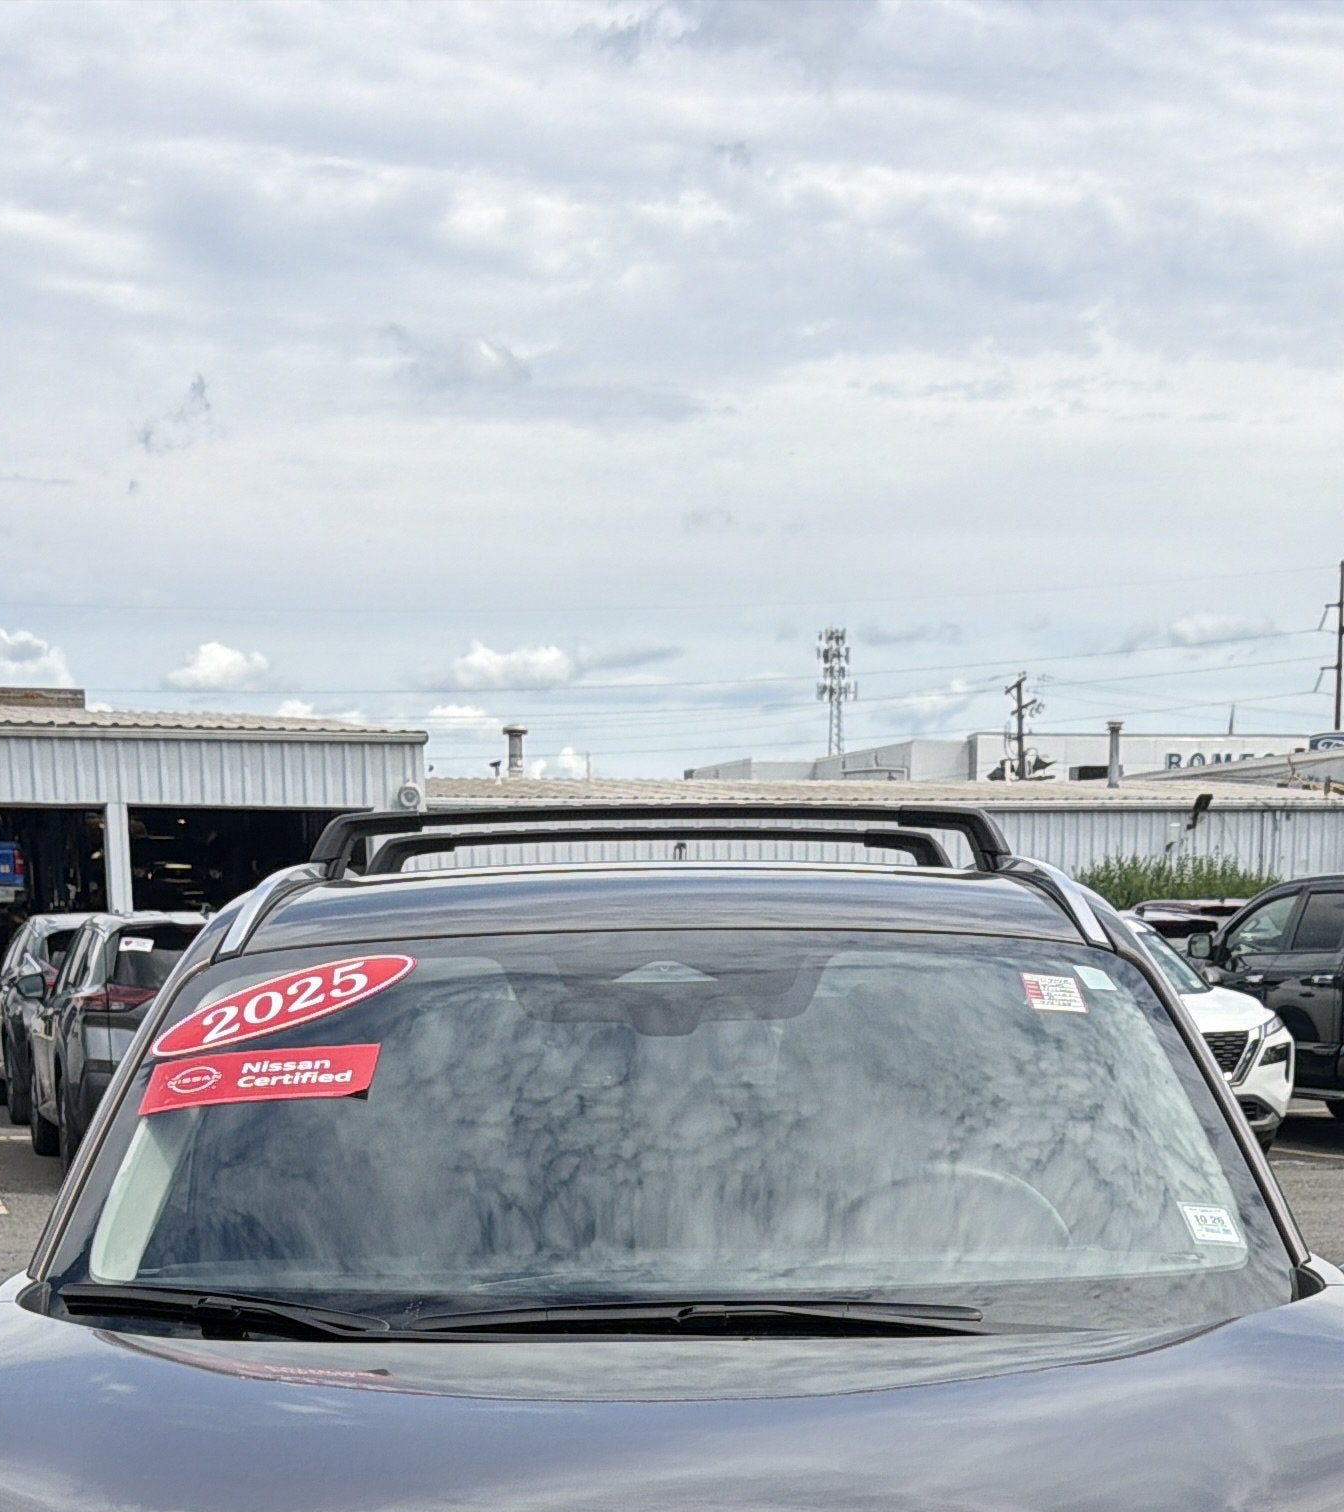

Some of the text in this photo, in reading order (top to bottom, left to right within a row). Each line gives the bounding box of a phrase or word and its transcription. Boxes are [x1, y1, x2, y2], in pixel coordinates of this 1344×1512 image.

[201, 961, 369, 1044] 2025
[241, 1058, 331, 1073] Nissan
[236, 1069, 352, 1089] Certified
